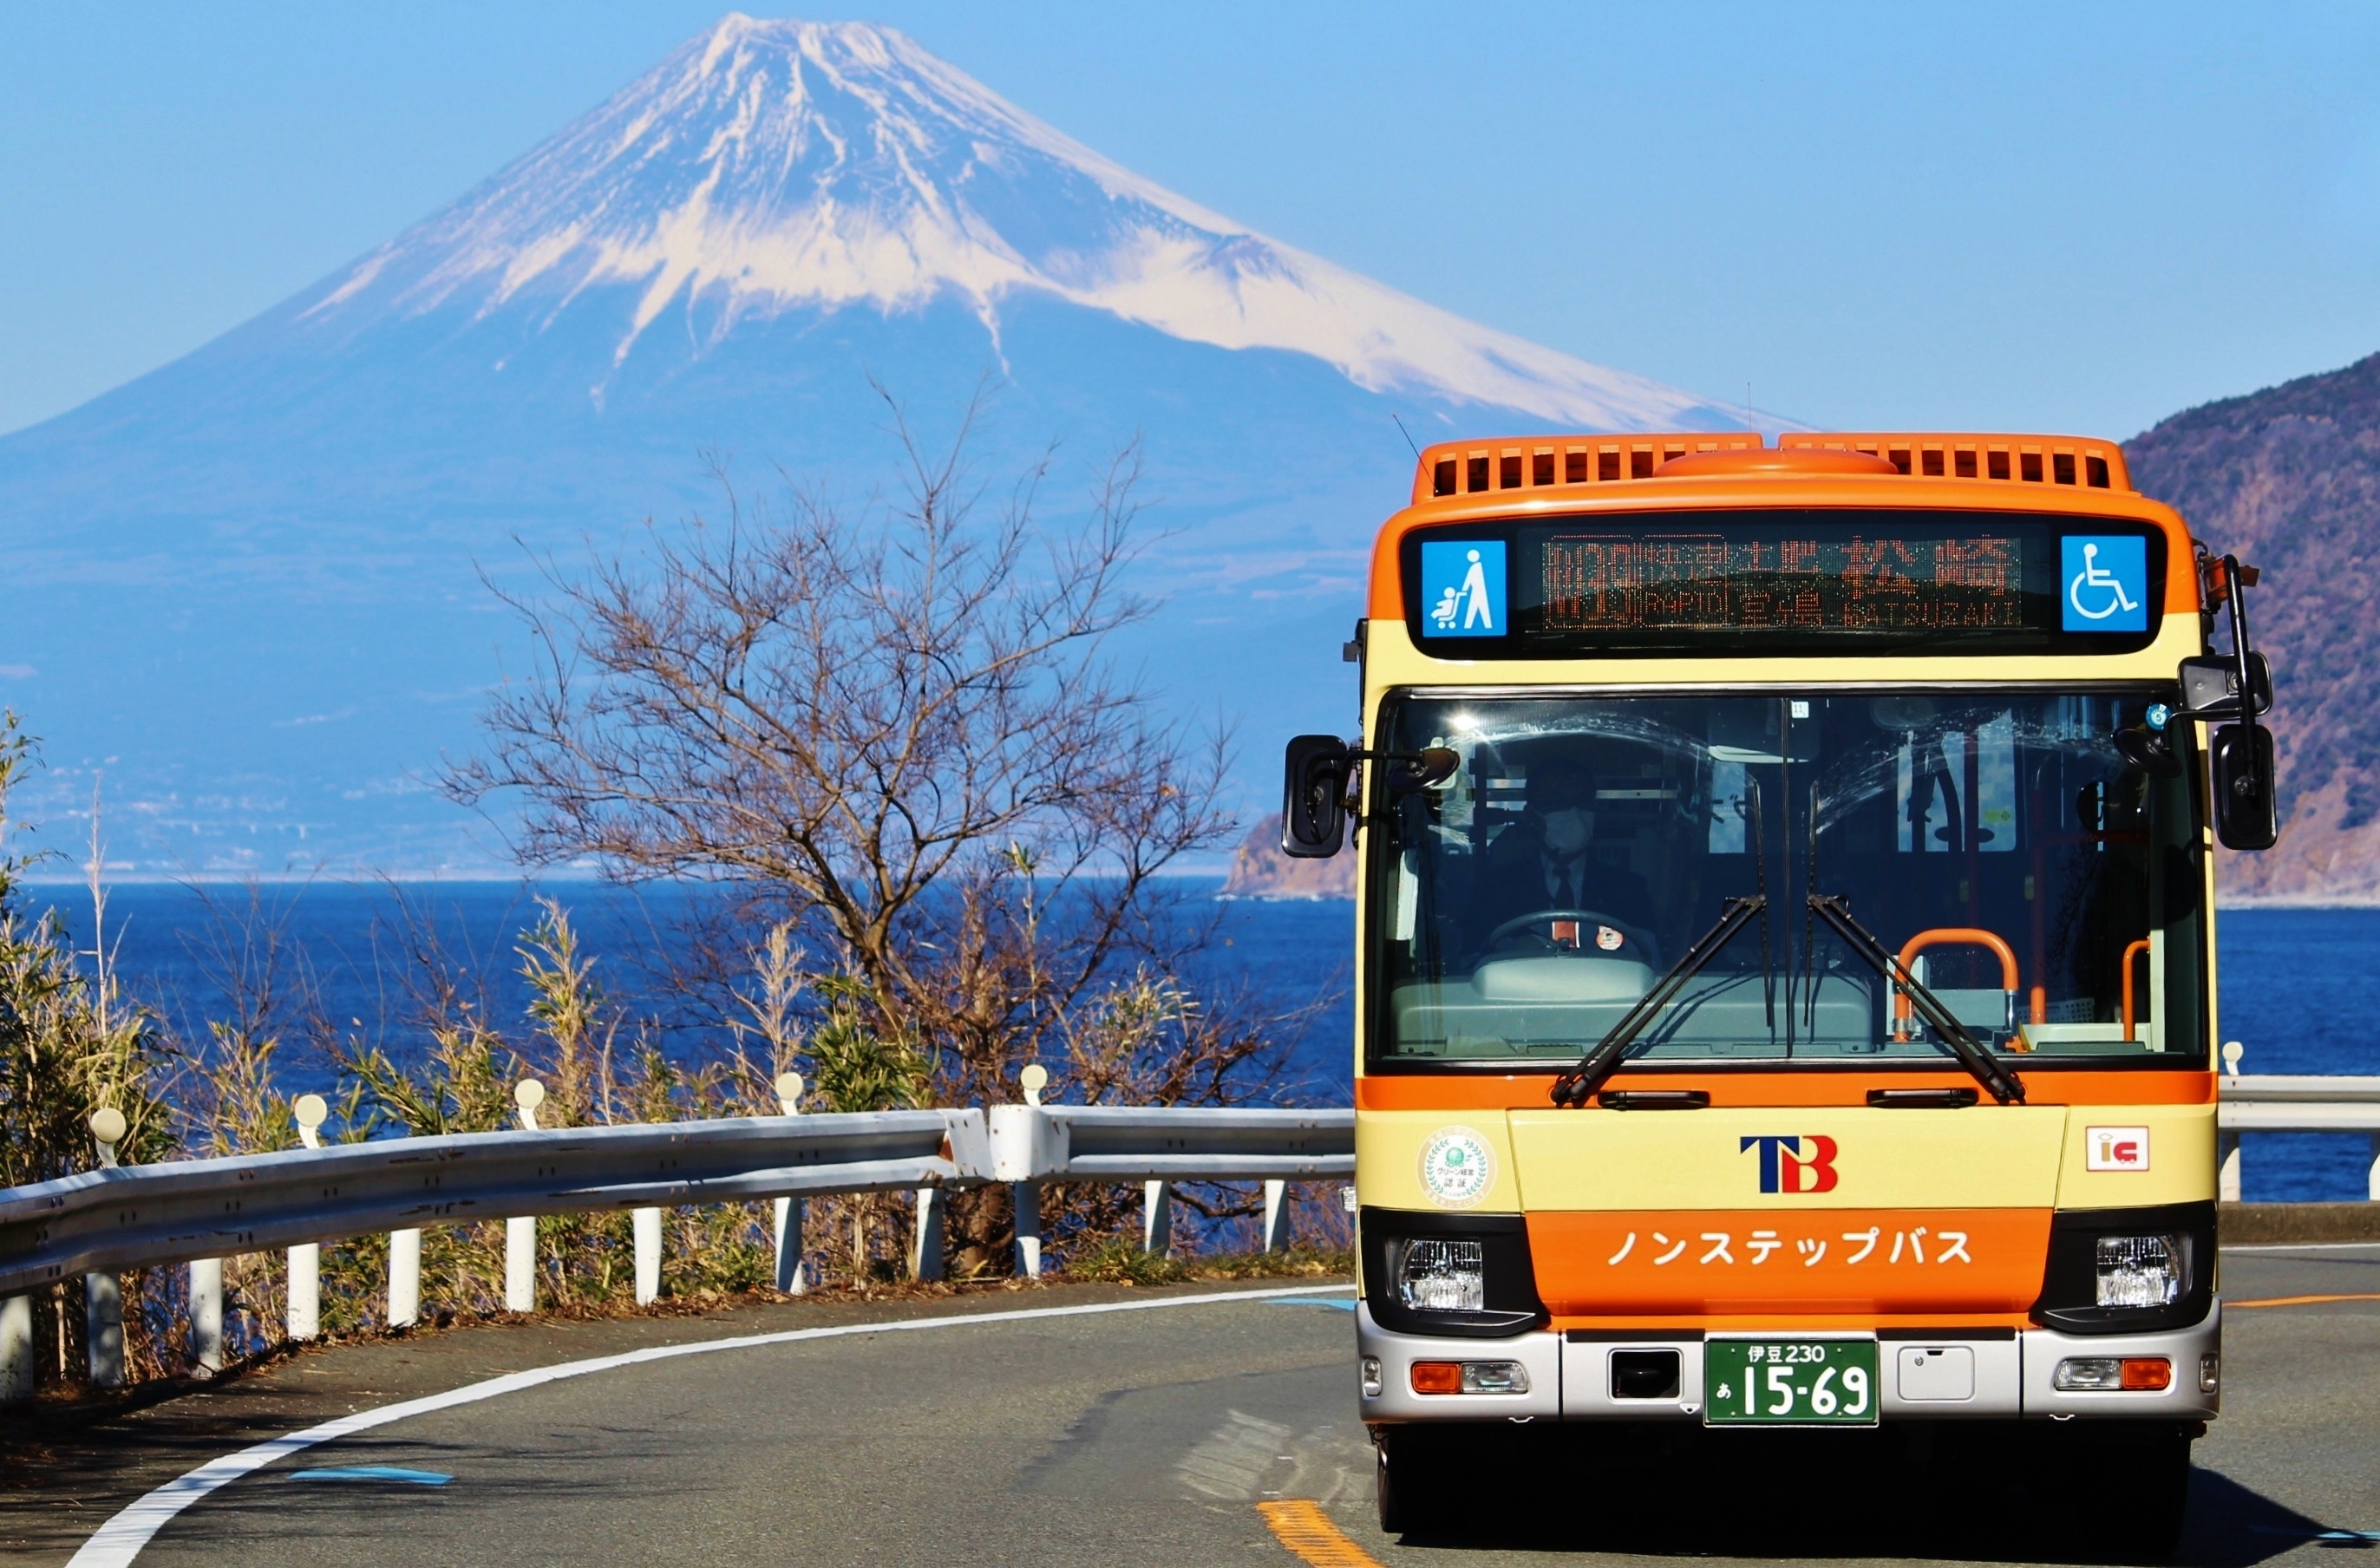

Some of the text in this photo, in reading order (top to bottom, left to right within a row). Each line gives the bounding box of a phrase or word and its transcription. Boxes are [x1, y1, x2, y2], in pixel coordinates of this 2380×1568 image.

[1841, 534, 2012, 600] 松崎
[1644, 591, 1722, 615] RAPID
[1437, 1167, 1474, 1176] グリーン経営
[1607, 1225, 1971, 1267] ノンステップバス
[1716, 1366, 1868, 1415] あ 15-69
